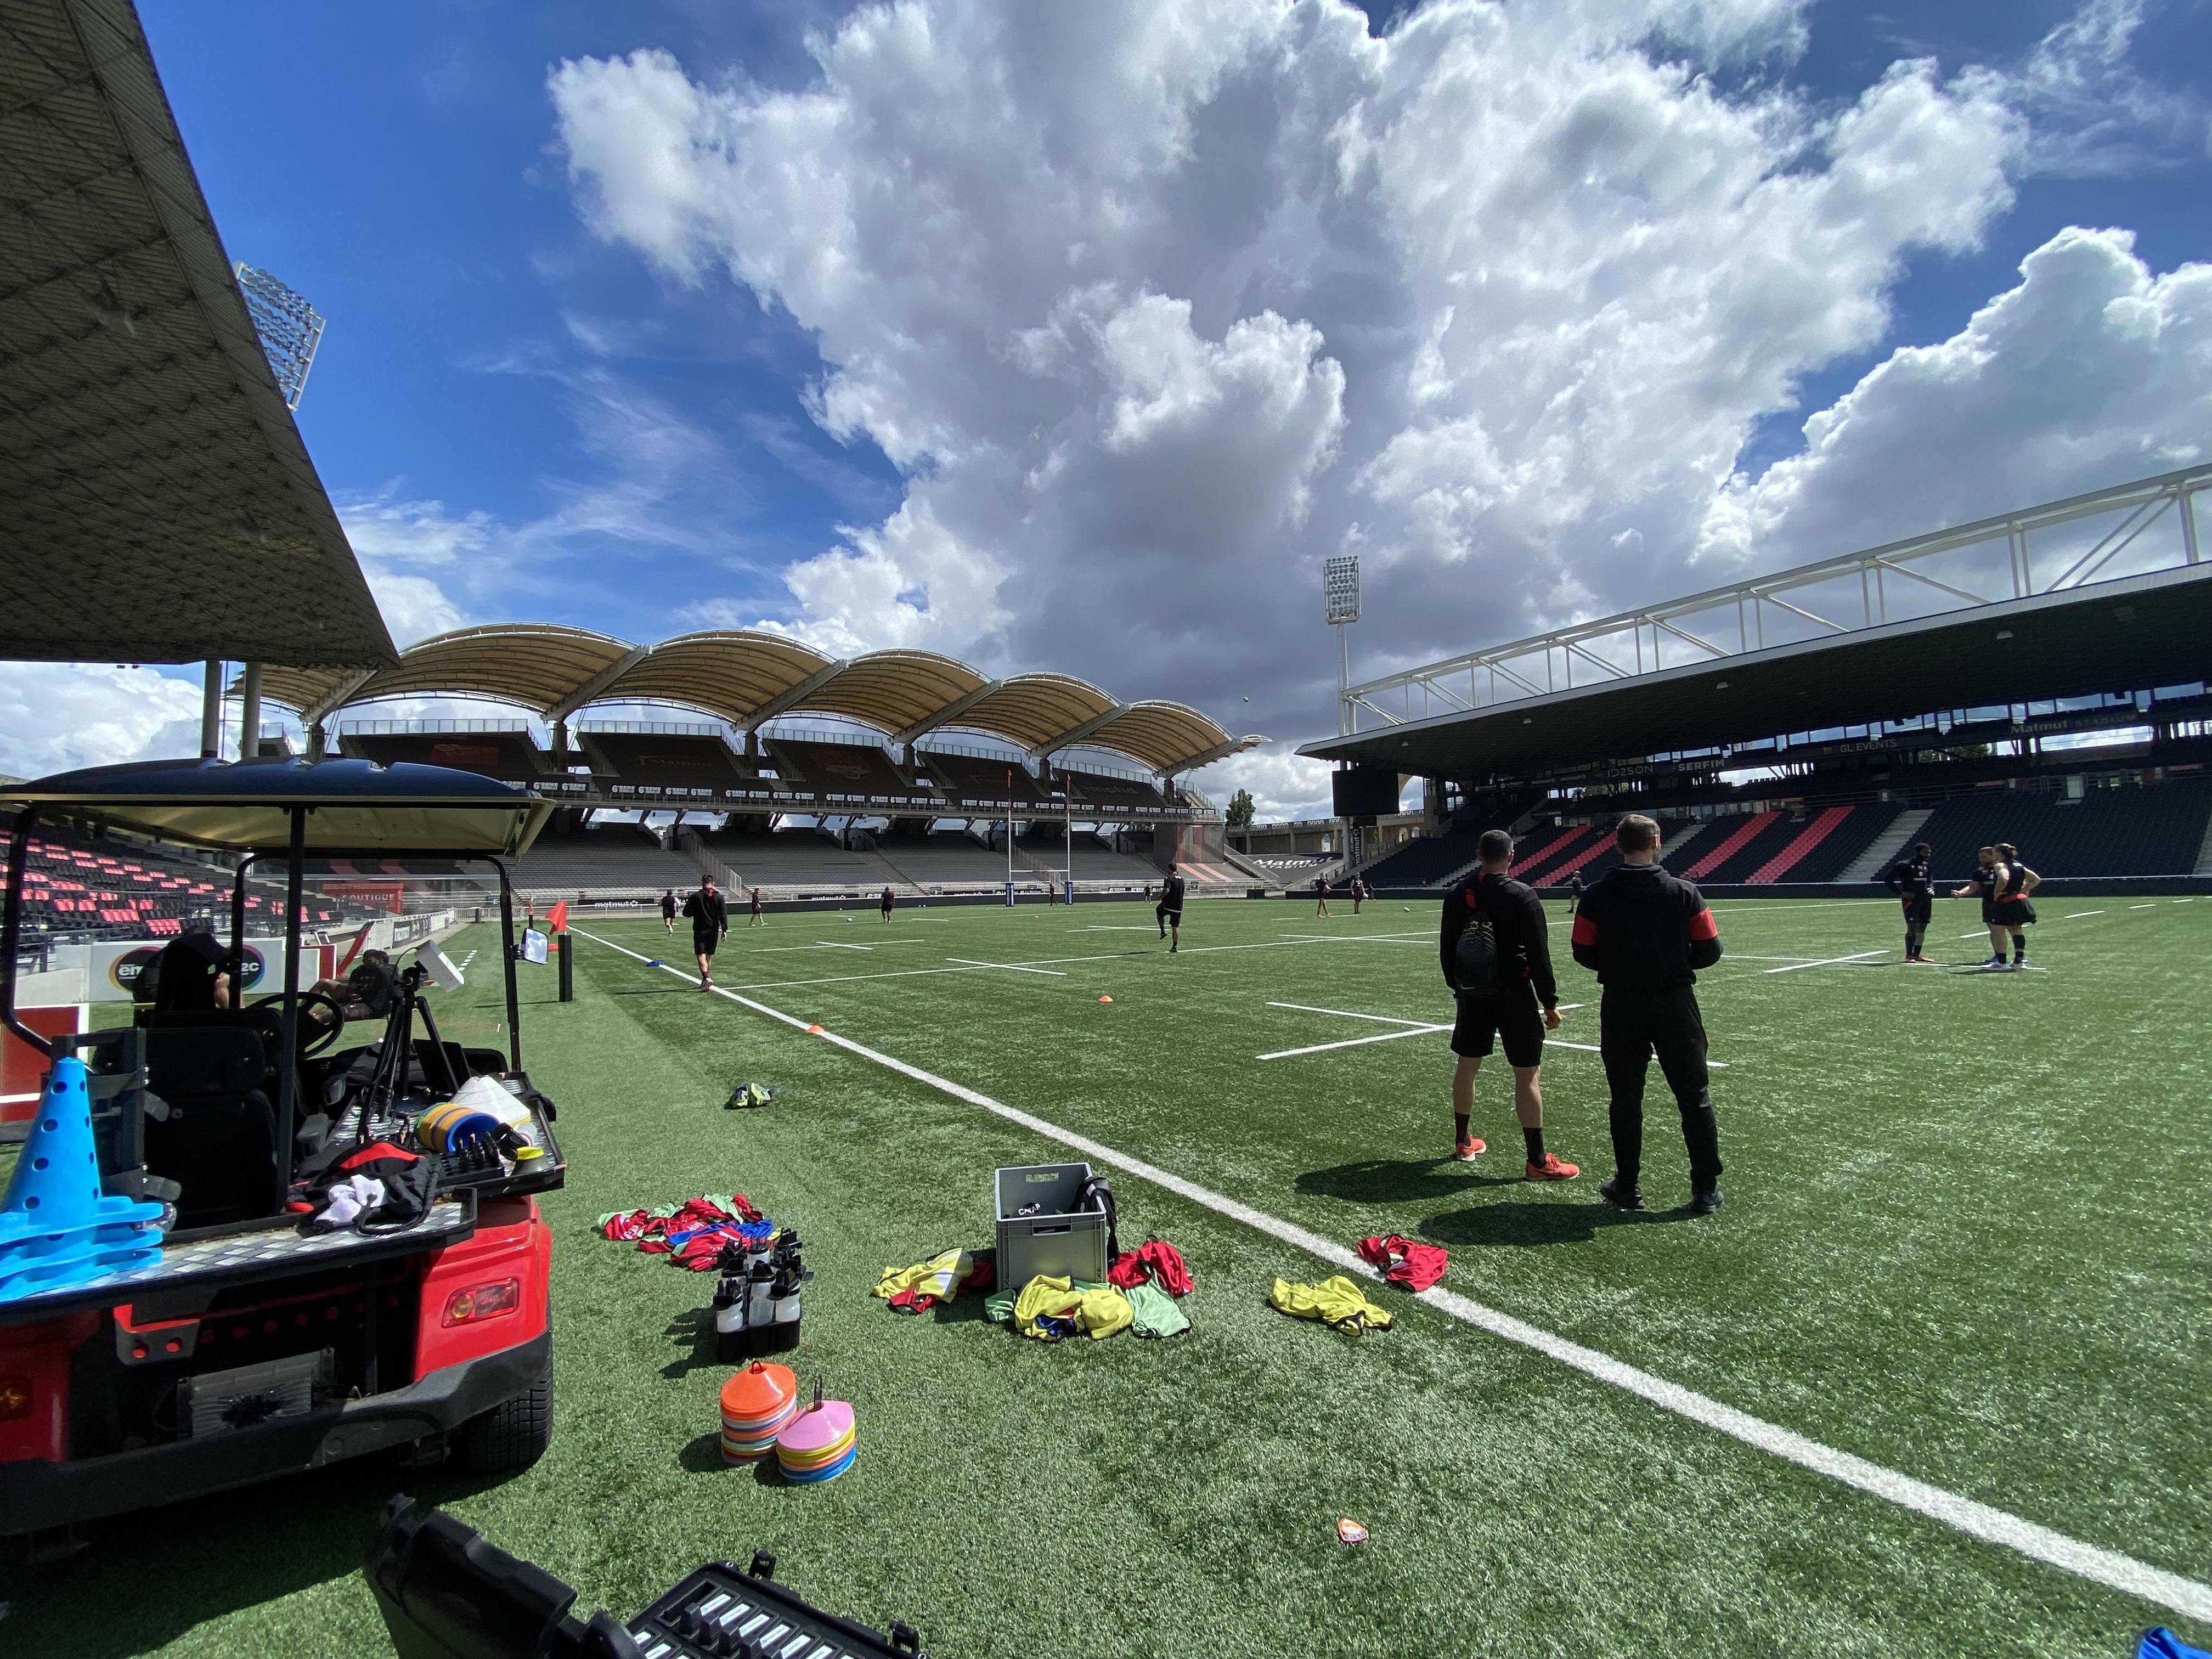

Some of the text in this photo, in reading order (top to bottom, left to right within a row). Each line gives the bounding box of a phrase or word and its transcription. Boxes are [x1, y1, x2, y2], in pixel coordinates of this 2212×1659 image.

[2011, 720, 2068, 734] Matmut
[1840, 738, 1897, 753] GL EVENTS
[1678, 759, 1725, 771] SERFIM
[1252, 856, 1334, 866] Matmut
